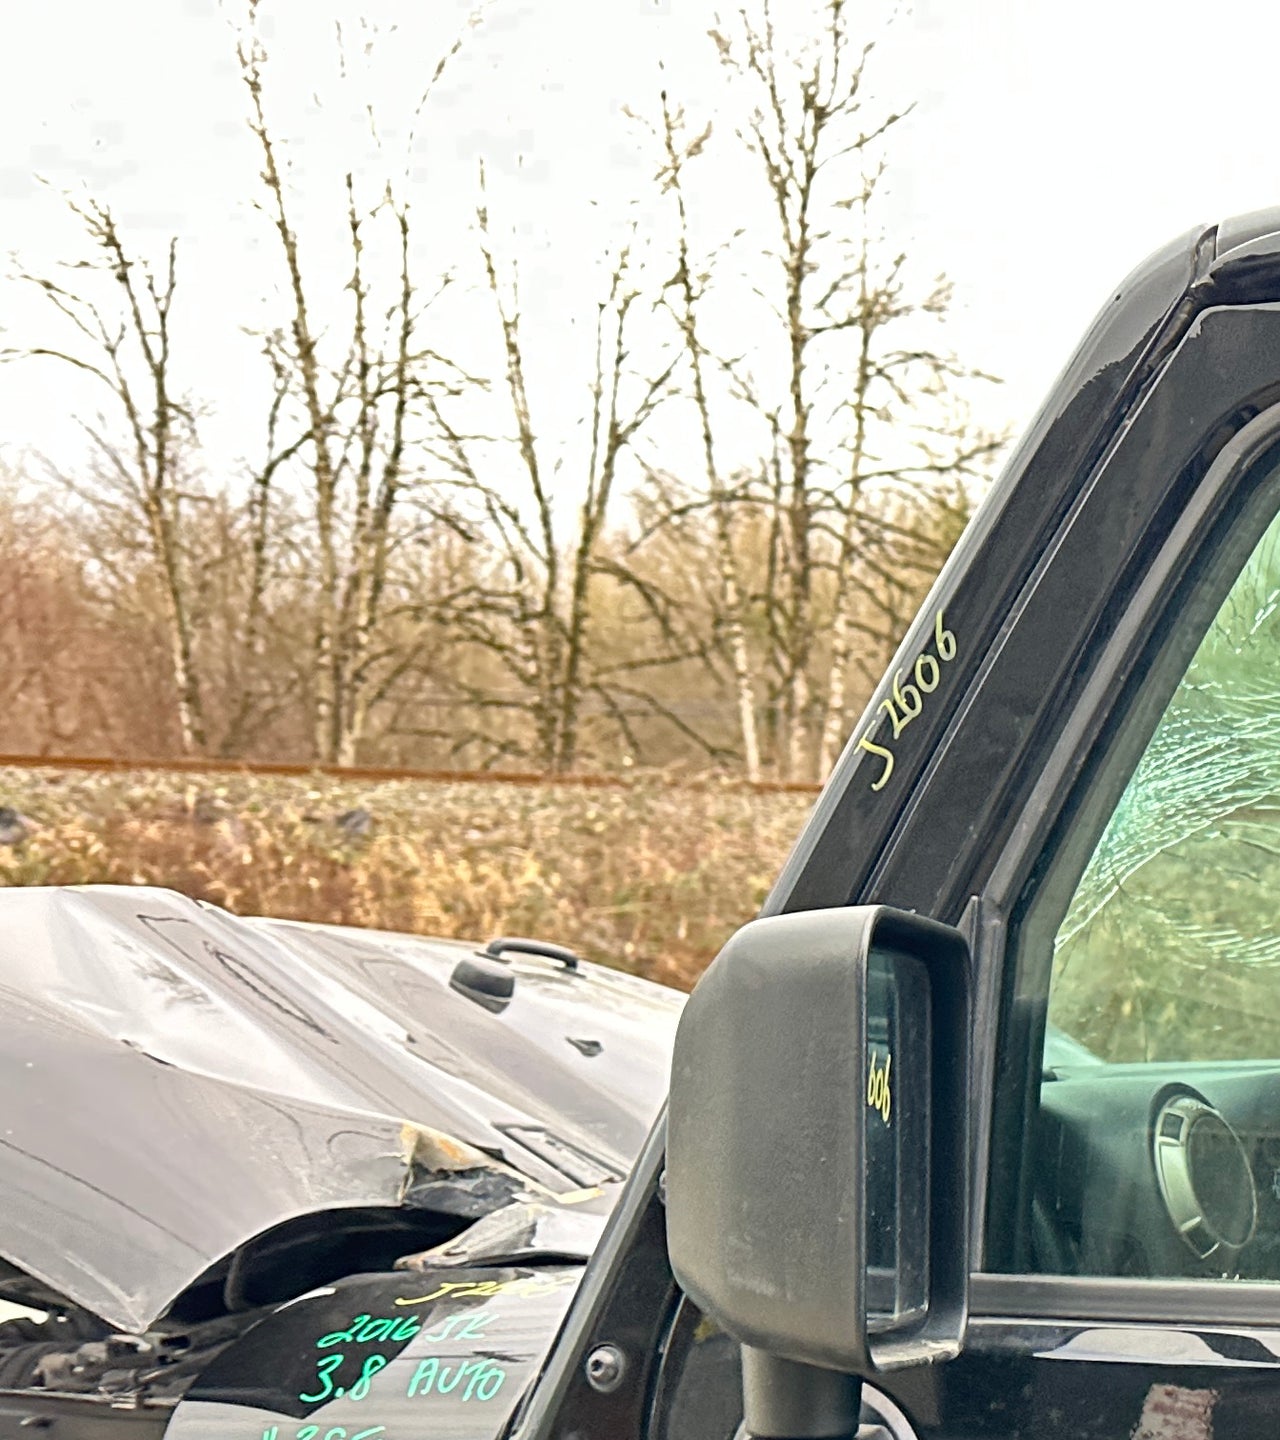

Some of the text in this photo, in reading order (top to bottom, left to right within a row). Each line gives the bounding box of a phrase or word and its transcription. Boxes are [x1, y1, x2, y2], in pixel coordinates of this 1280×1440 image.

[853, 609, 957, 791] J2606
[317, 1314, 421, 1348] 2016
[301, 1354, 506, 1402] 3.8 AUTO
